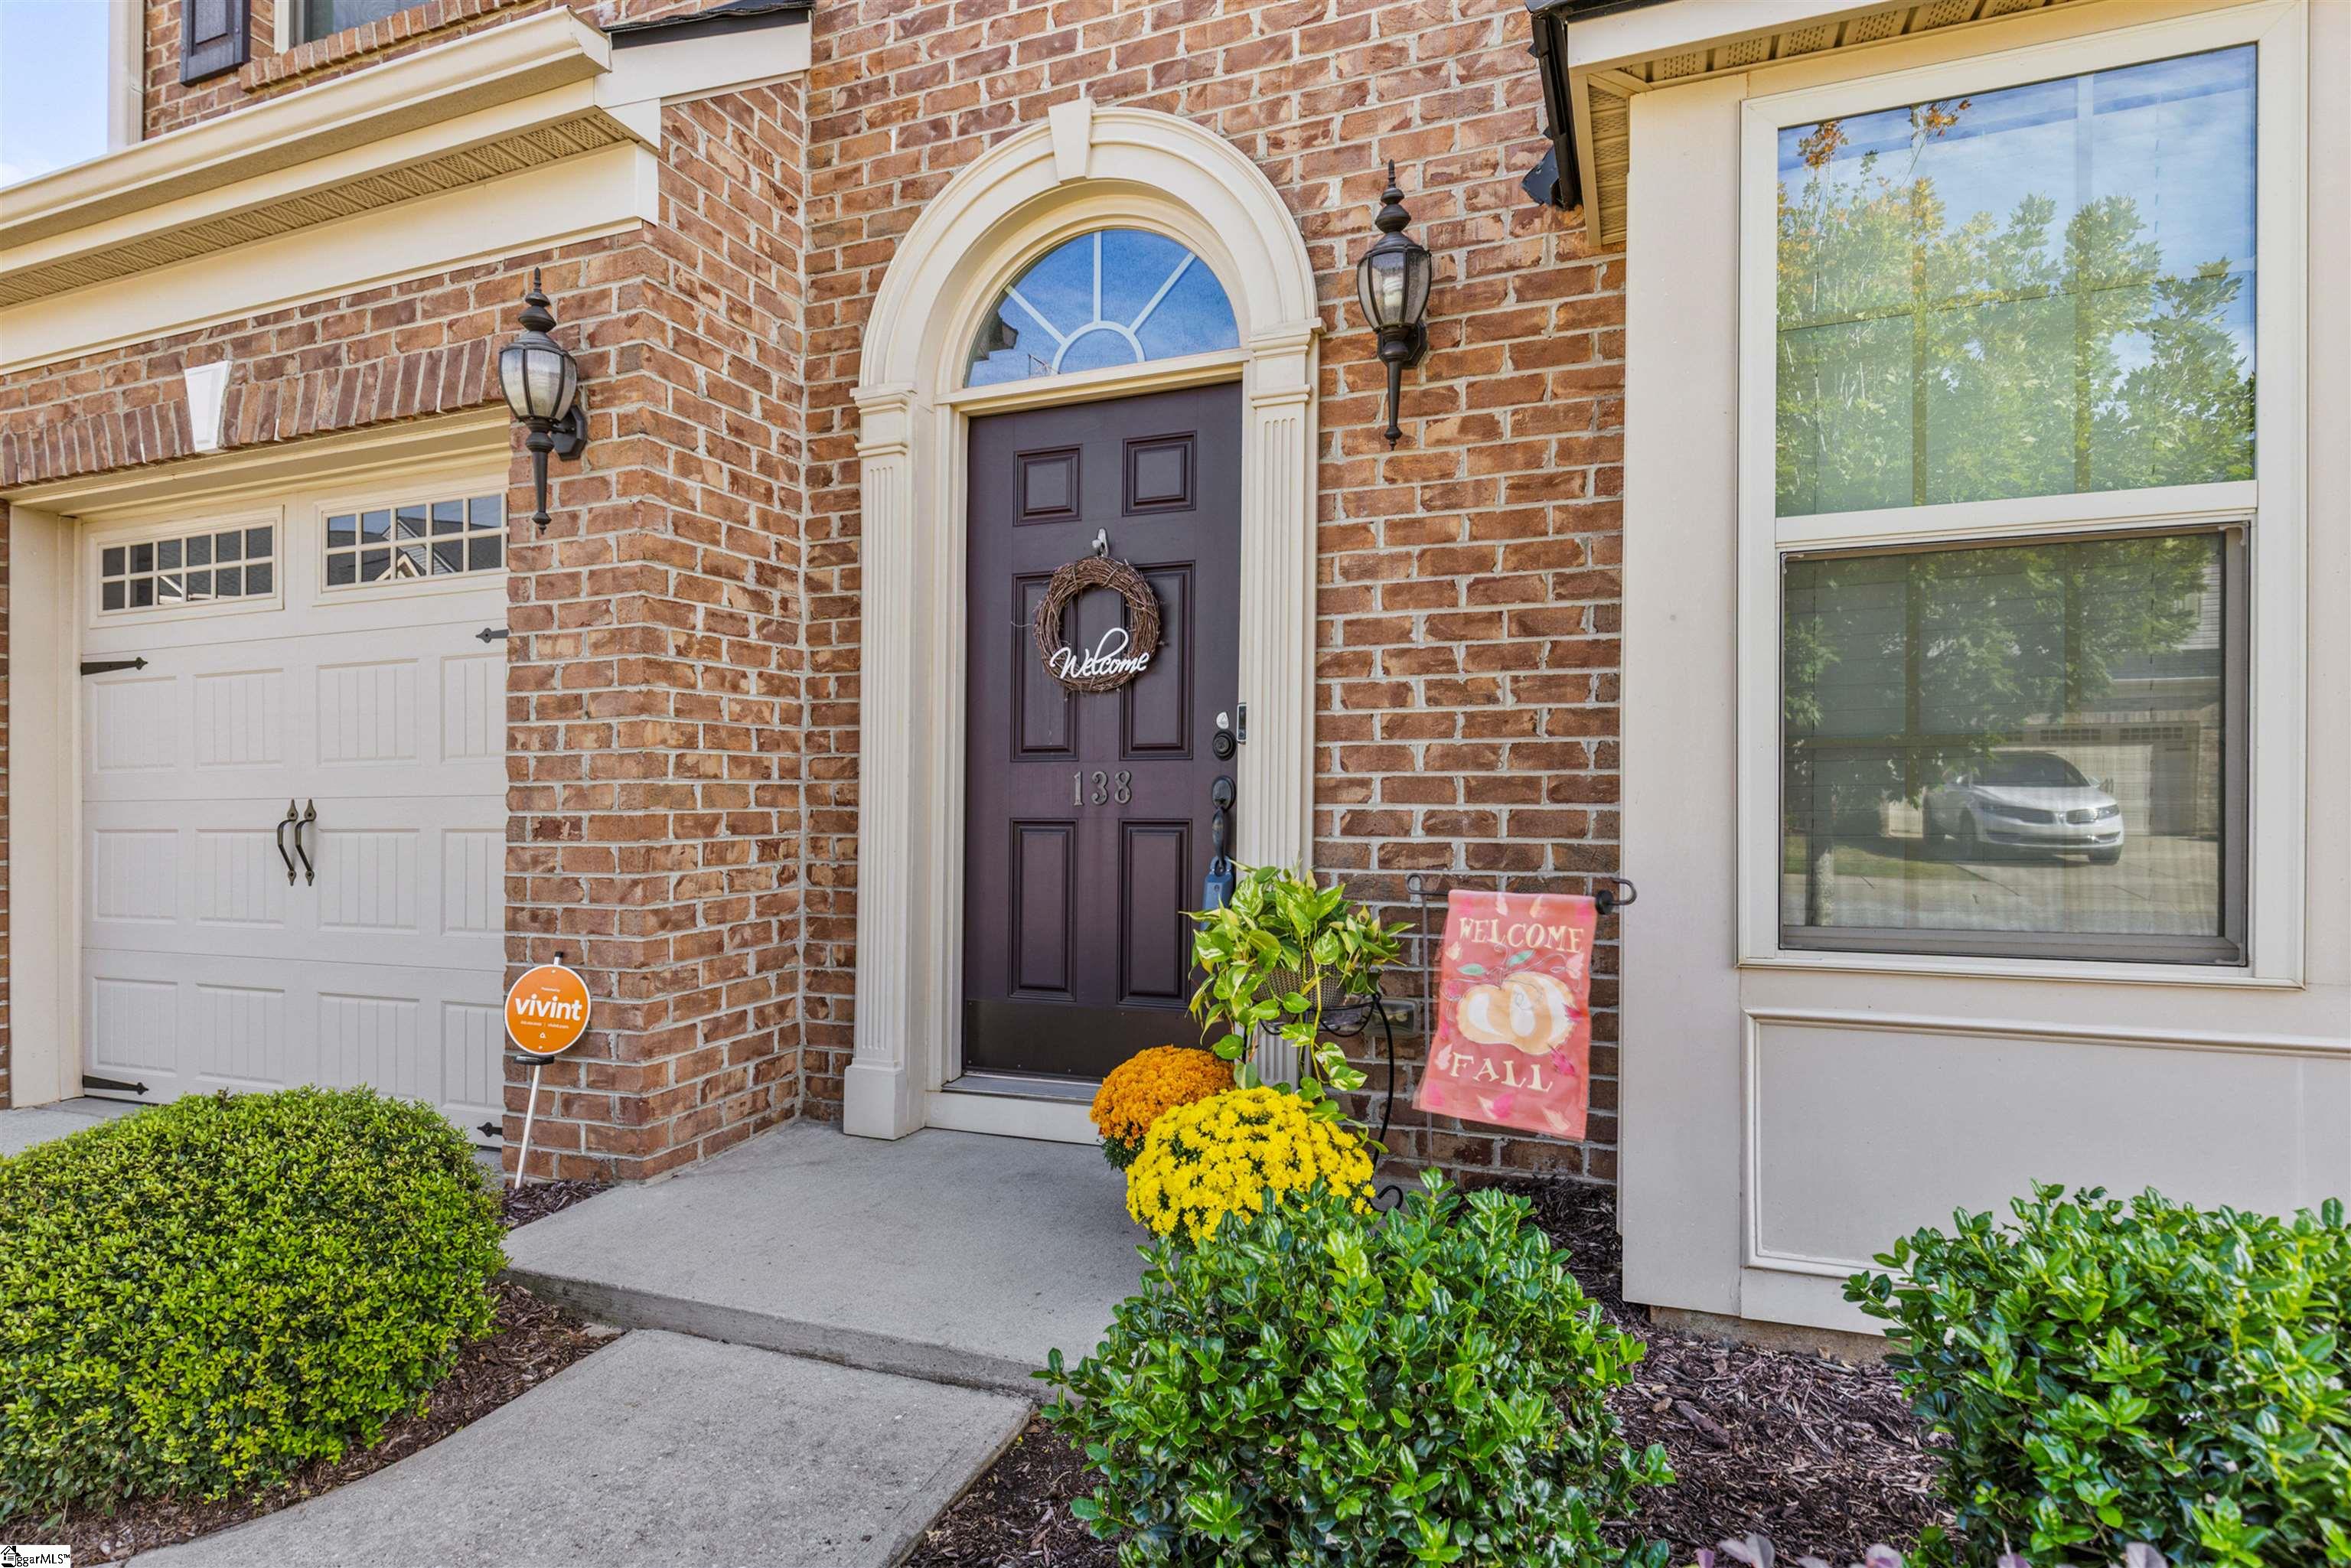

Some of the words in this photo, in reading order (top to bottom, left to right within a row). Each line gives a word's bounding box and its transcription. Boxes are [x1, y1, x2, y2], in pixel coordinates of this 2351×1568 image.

[1050, 628, 1149, 679] Welcome
[1074, 771, 1132, 806] 138
[1459, 918, 1584, 954] WELCOME
[515, 994, 582, 1021] vivint
[1449, 1052, 1554, 1093] FALL
